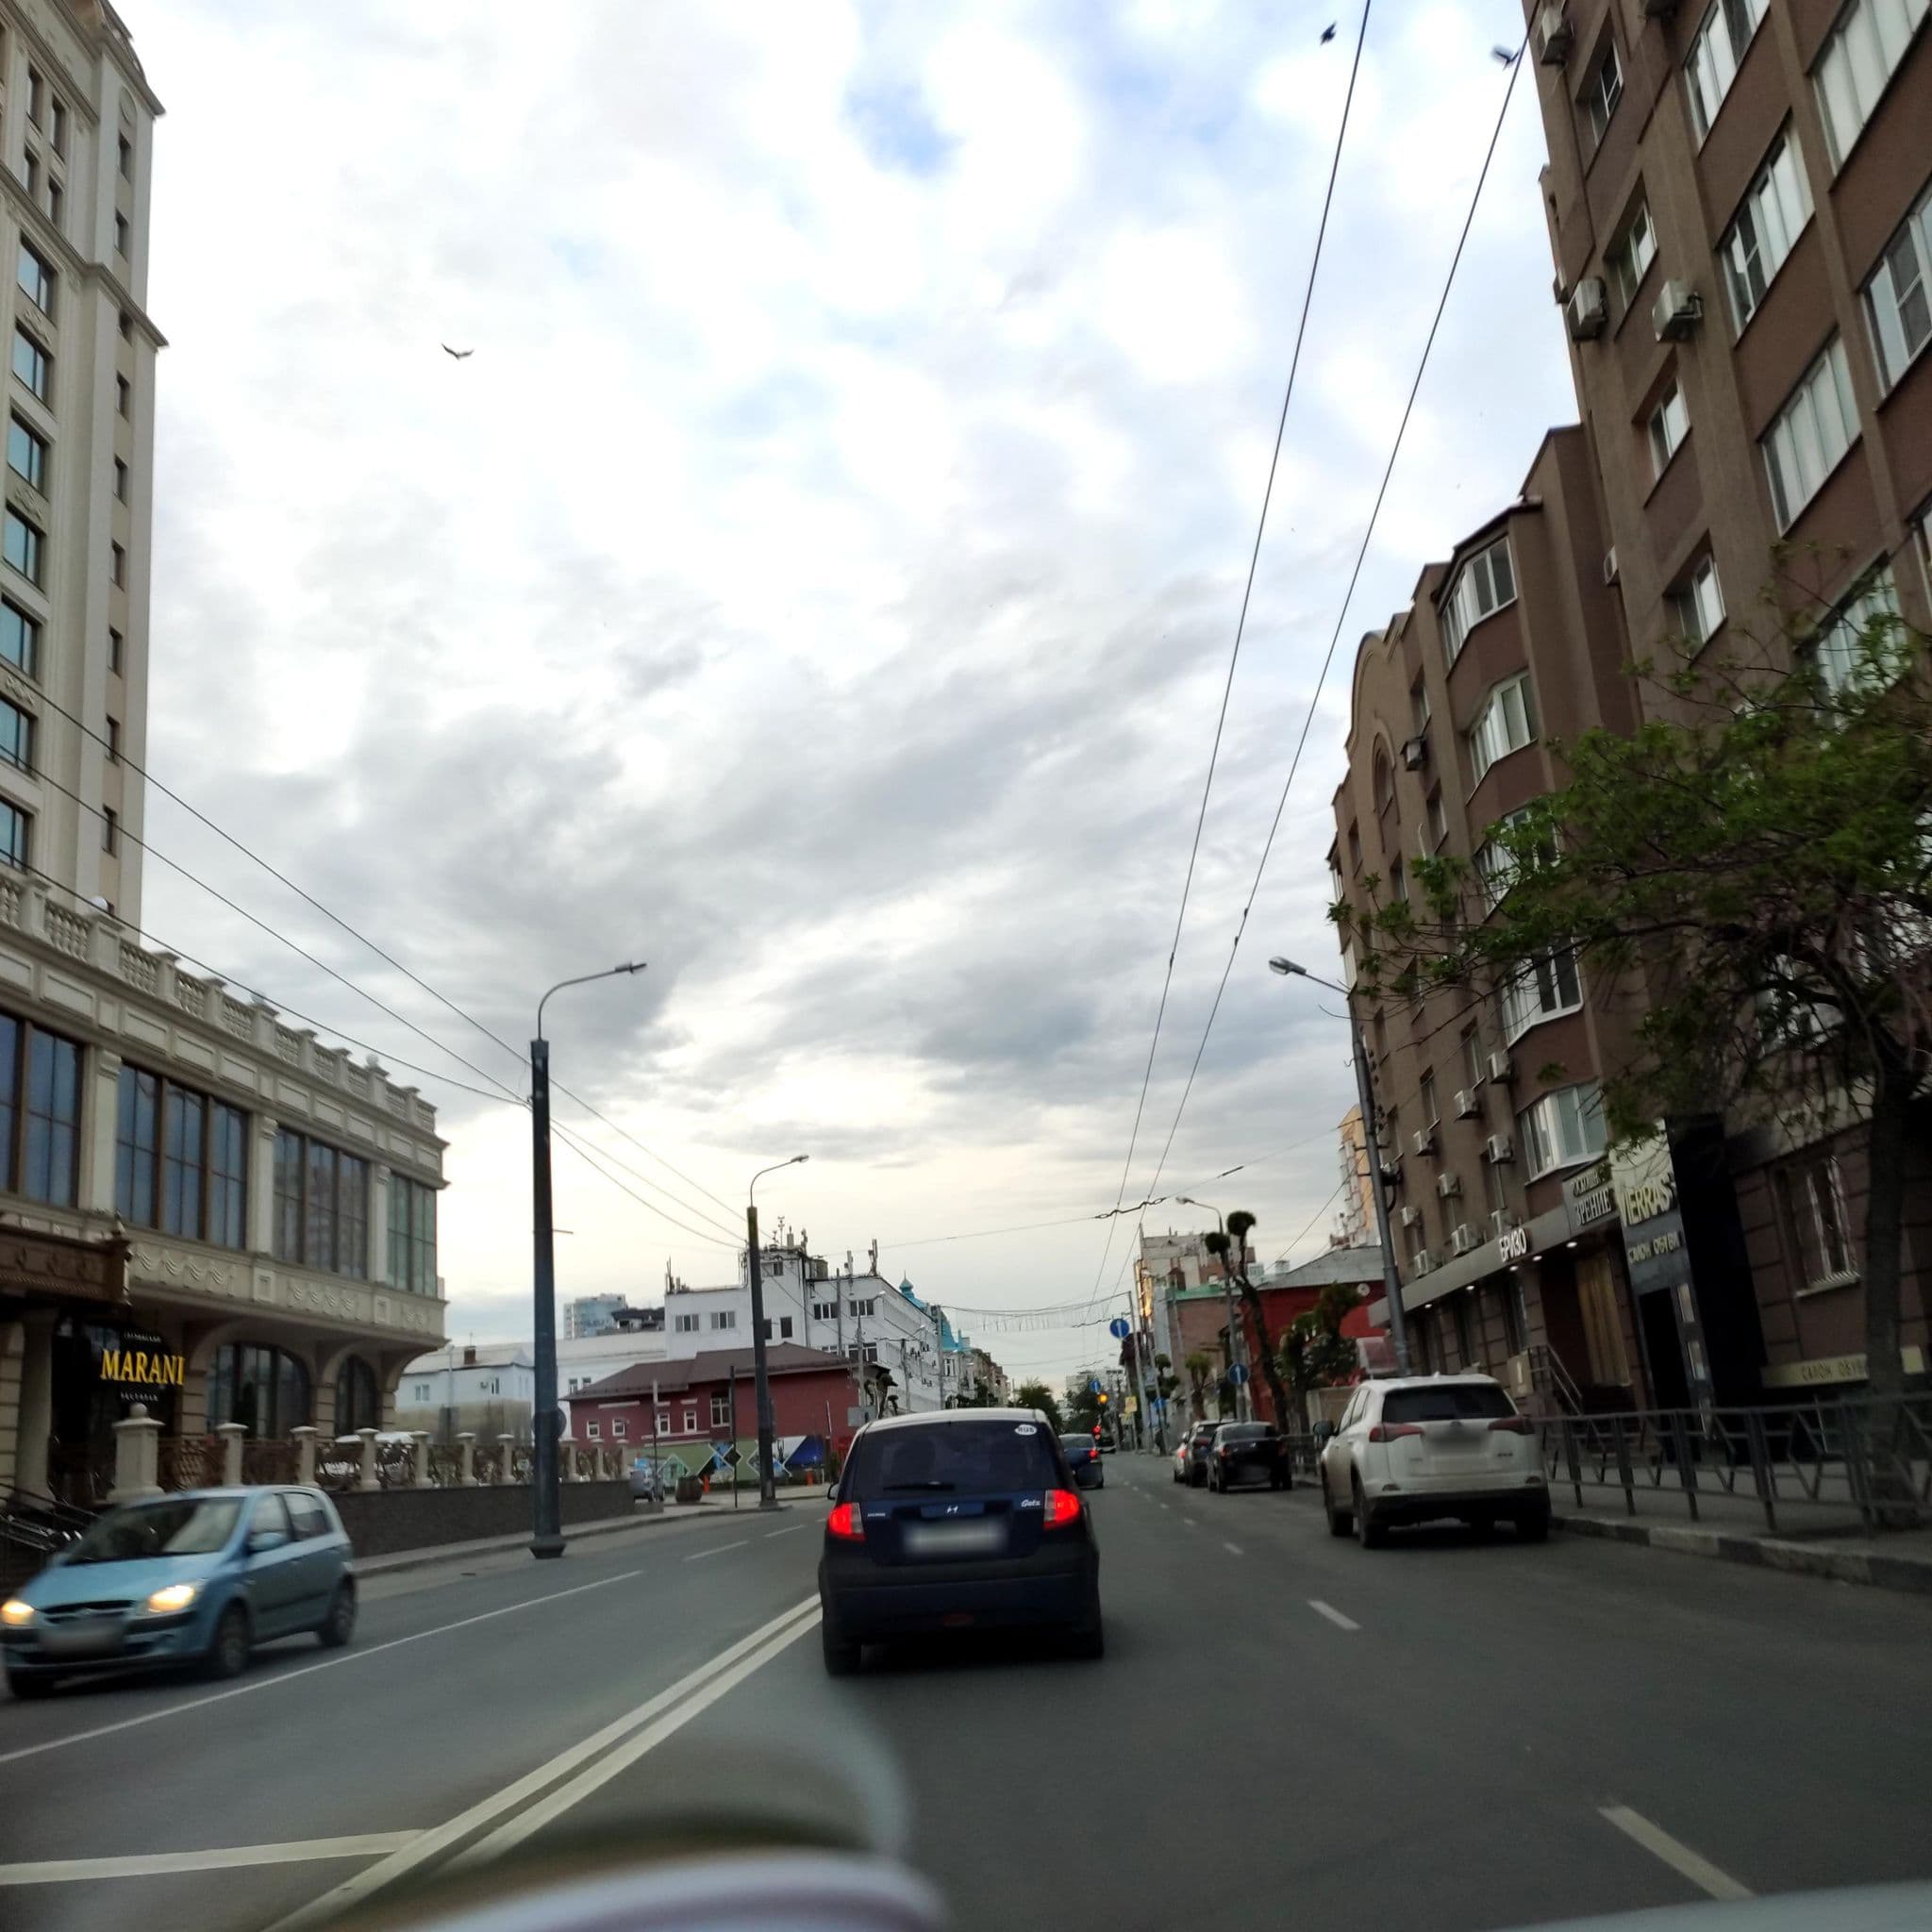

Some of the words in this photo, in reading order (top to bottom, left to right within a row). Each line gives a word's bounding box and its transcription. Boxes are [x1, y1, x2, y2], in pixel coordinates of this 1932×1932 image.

[1574, 1188, 1612, 1226] ЗРЕНИЕ
[1498, 1227, 1527, 1262] БРИЗО
[99, 1348, 185, 1386] MARANI
